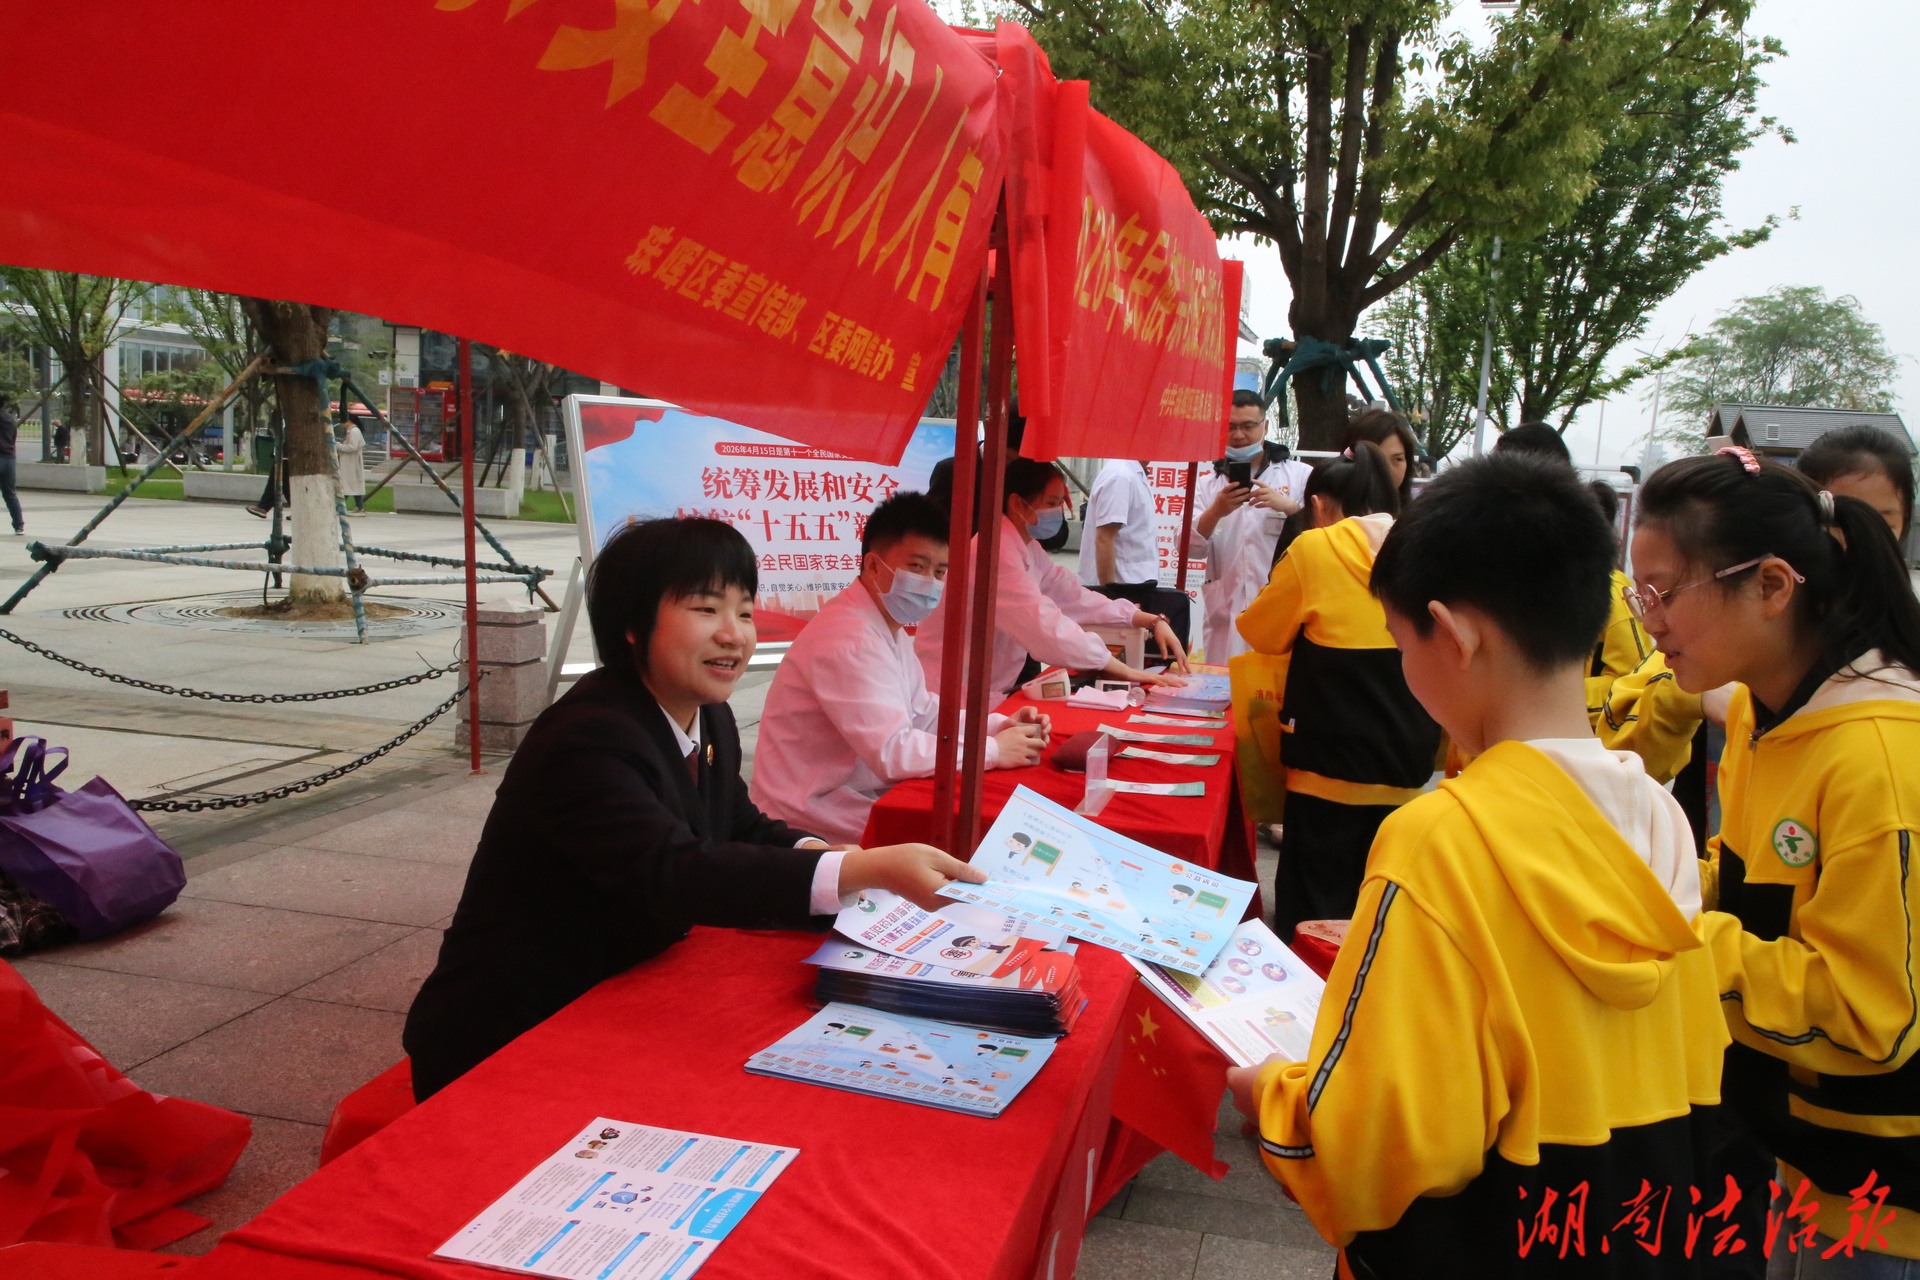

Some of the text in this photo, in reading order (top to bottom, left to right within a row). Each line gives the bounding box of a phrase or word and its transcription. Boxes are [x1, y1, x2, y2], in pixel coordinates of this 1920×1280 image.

[700, 466, 900, 503] 统筹发展和安全
